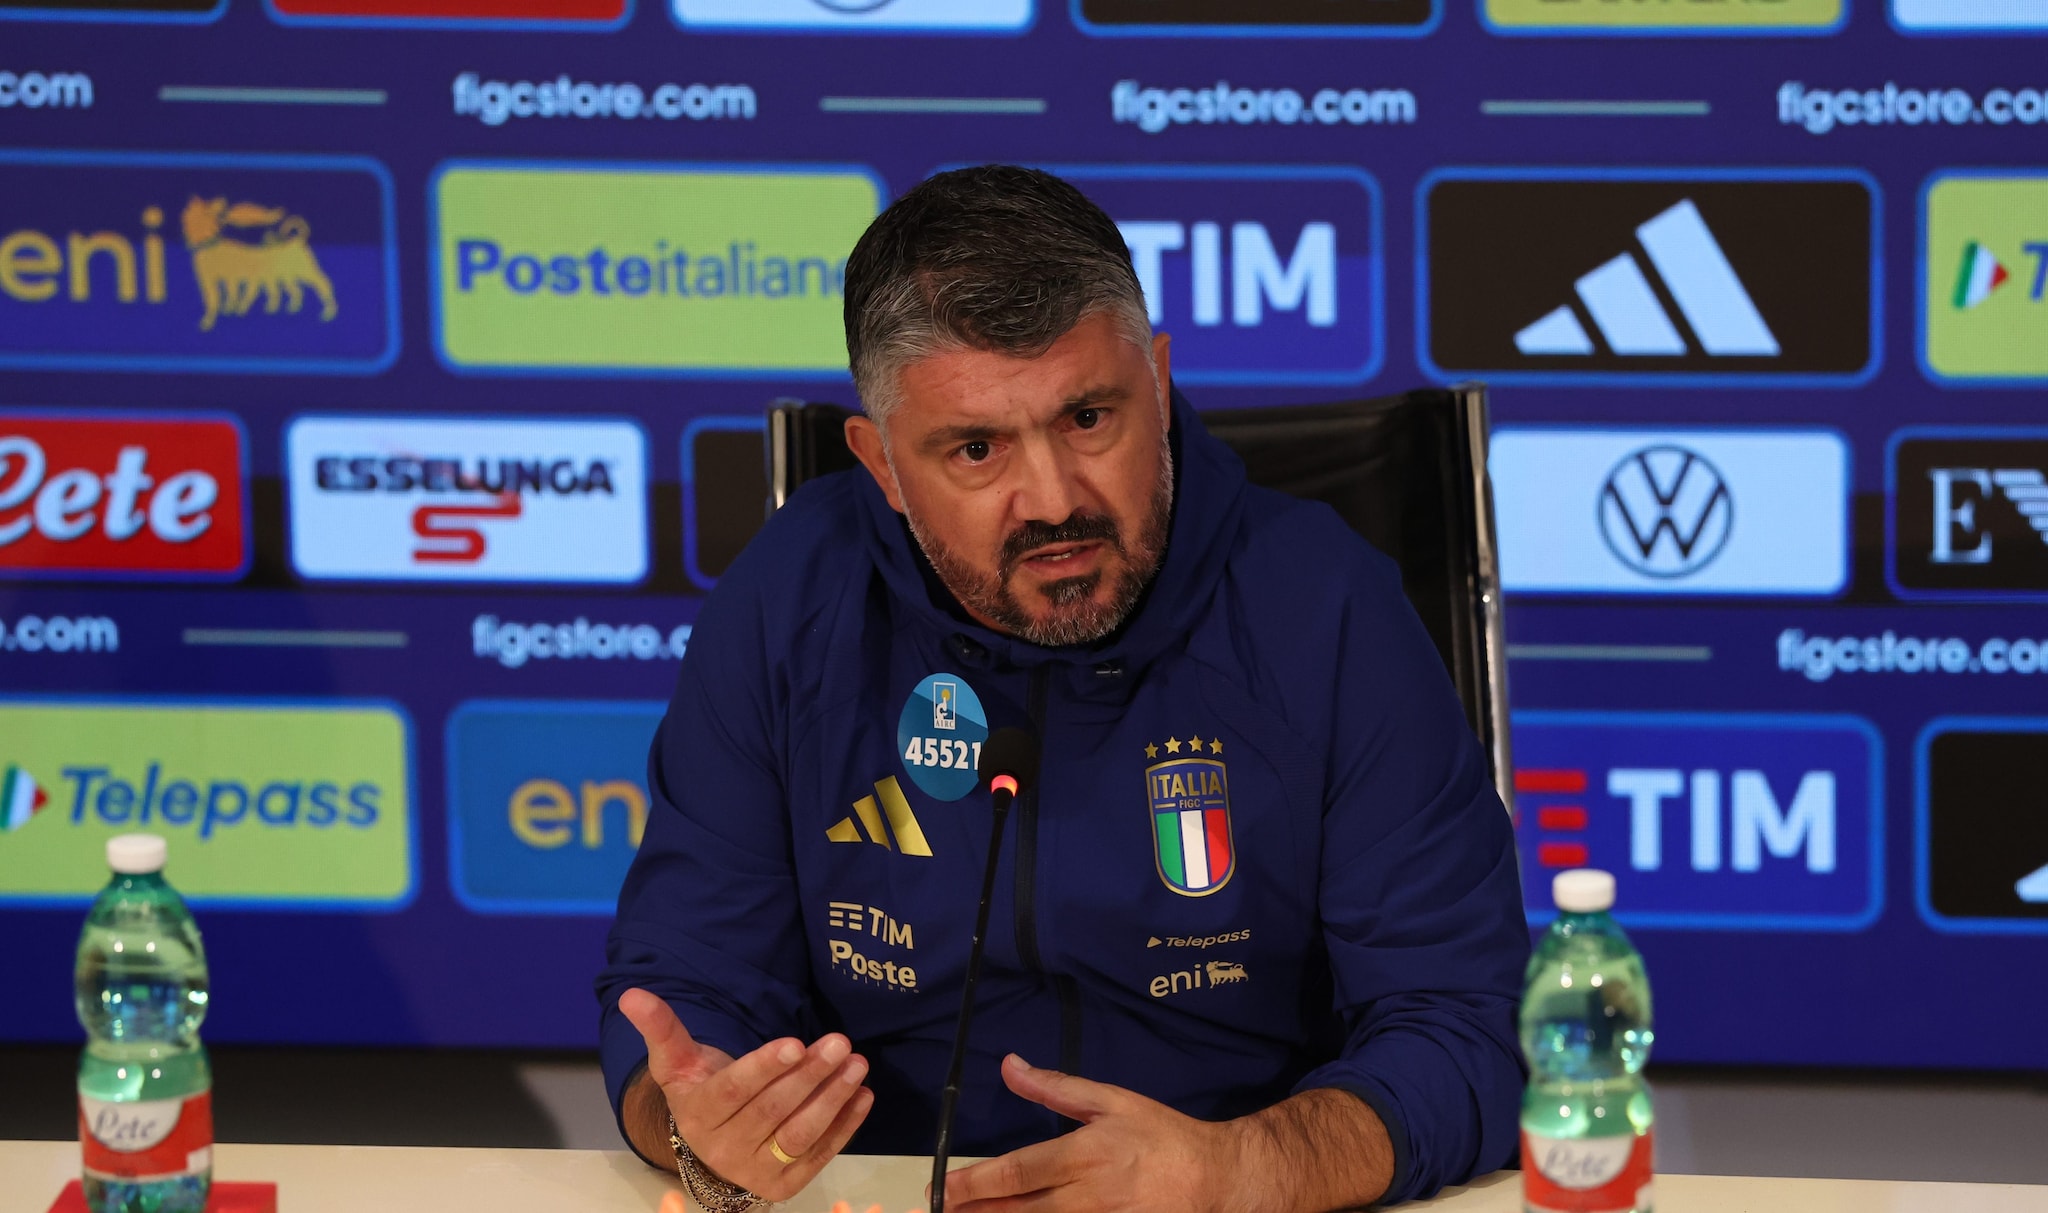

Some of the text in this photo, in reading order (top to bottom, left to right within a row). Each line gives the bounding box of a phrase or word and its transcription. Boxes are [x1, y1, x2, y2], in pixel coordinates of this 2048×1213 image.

[453, 72, 757, 125] figcstore.com
[1112, 80, 1416, 132] figcstore.com
[1778, 80, 2048, 134] figcstore.co
[0, 206, 165, 302] eni
[1116, 222, 1336, 326] TIM
[316, 456, 615, 494] ESSELUNGA
[0, 614, 118, 652] .com
[1778, 629, 2048, 682] figcstore.co
[935, 719, 955, 729] AIRC
[905, 736, 982, 771] 45521
[60, 760, 381, 840] Telepass
[1152, 771, 1223, 800] ITALIA
[1179, 799, 1201, 809] FIGC
[1607, 768, 1836, 873] TIM
[868, 906, 914, 950] TIM
[1165, 929, 1251, 949] Telepass
[829, 939, 917, 988] Poste
[1149, 963, 1202, 998] eni
